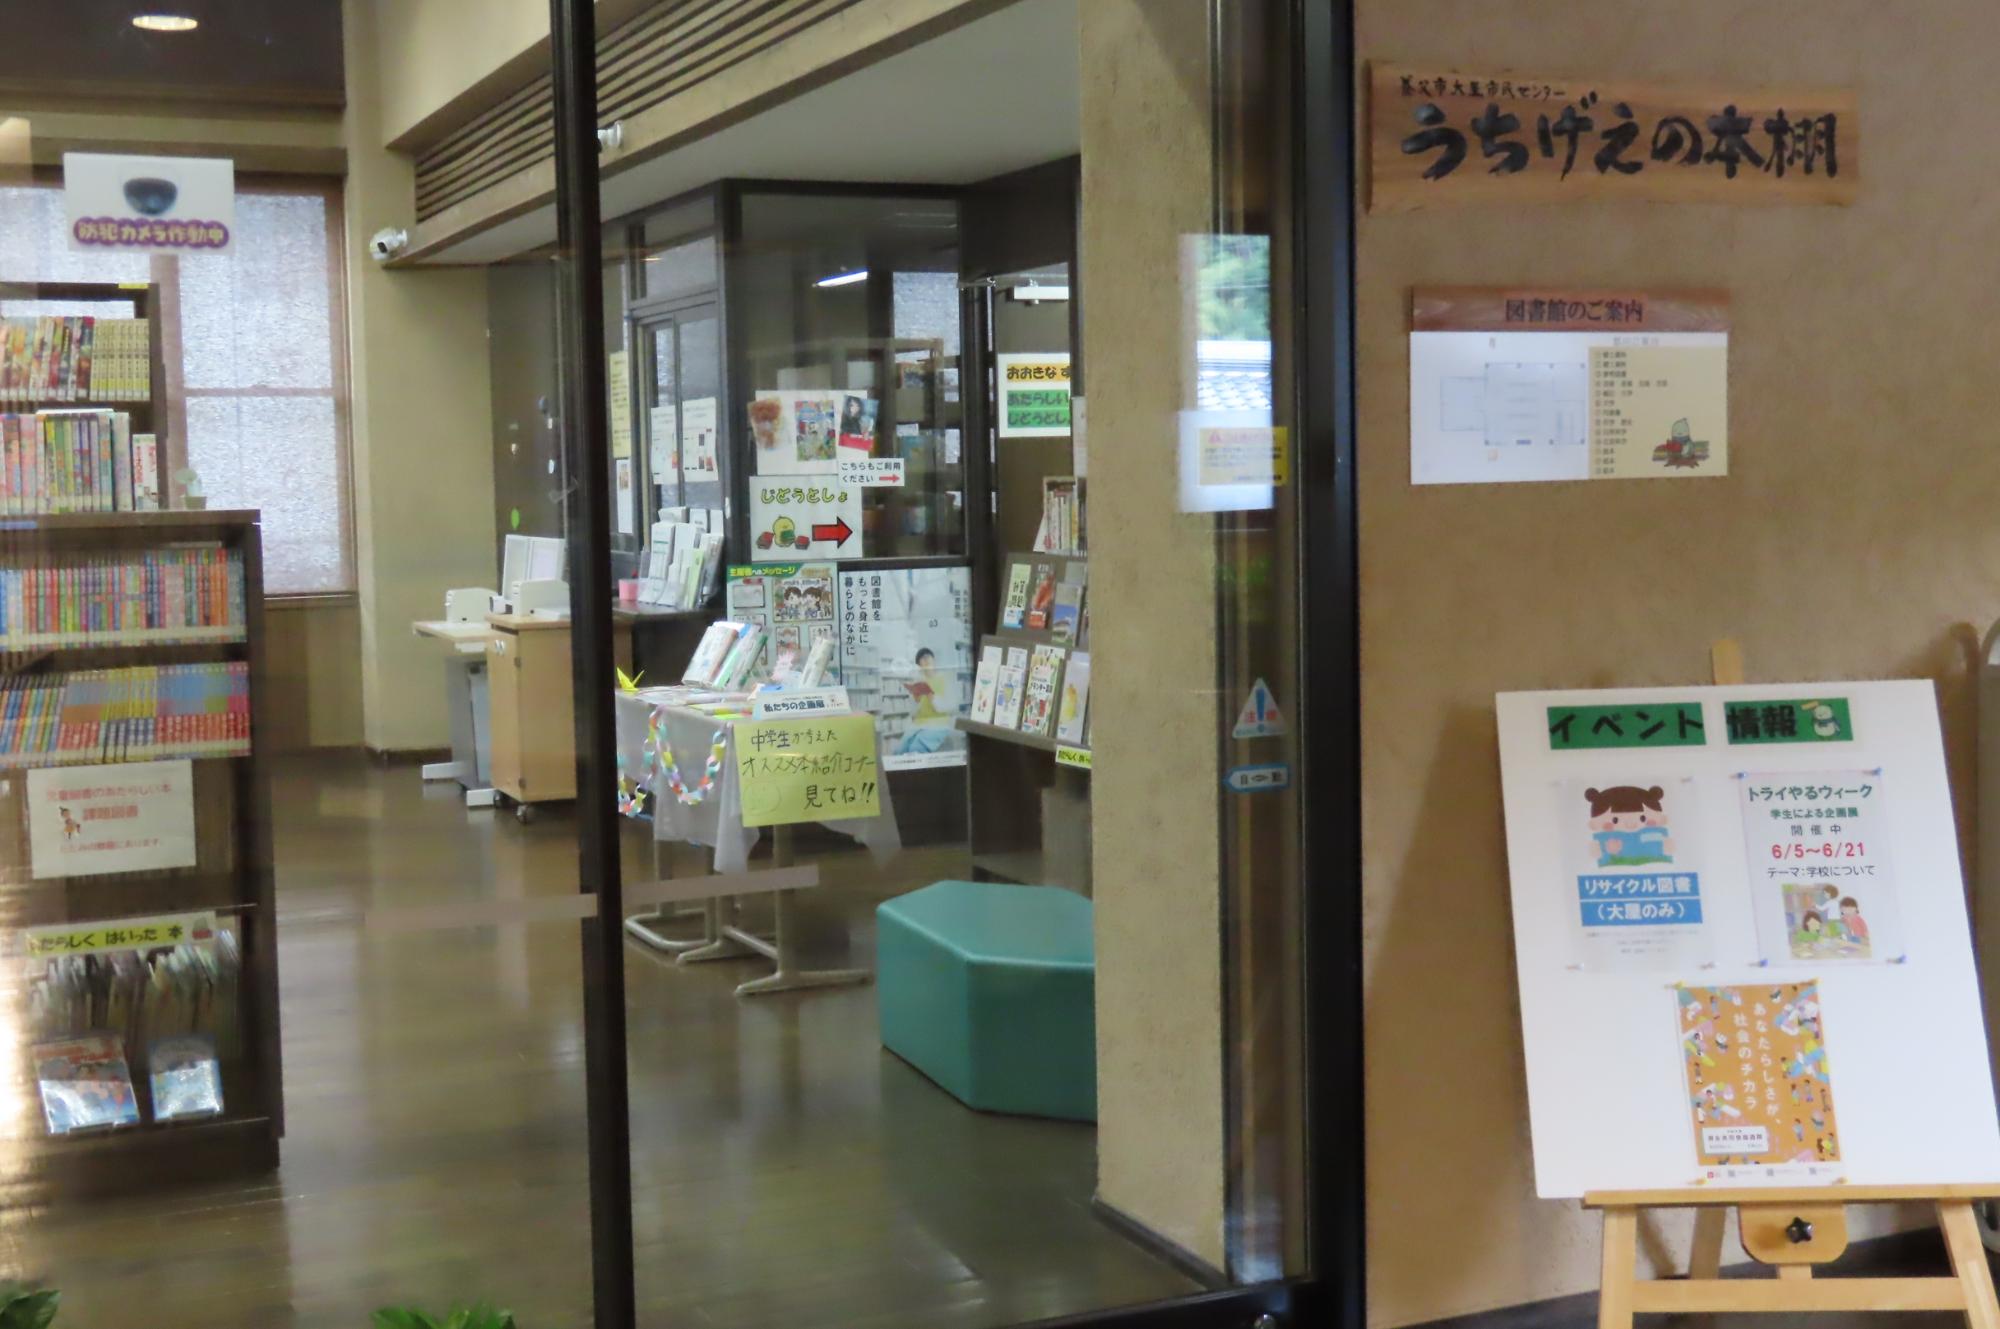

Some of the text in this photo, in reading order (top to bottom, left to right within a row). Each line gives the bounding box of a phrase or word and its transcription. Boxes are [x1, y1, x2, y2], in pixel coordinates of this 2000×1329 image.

[1401, 91, 1838, 181] うちげえの本棚
[1505, 299, 1643, 322] 図書館のご案内
[1007, 365, 1057, 380] おおきな
[1007, 411, 1070, 426] じどうとし
[841, 462, 901, 471] こちらもご利用
[842, 475, 873, 483] ください
[761, 487, 848, 504] じどうとしょ
[871, 576, 882, 621] 図書館を
[845, 576, 856, 657] 暮らしのなかに
[858, 576, 869, 645] もっと身近に
[1550, 704, 1798, 743] イベント 情報
[1748, 784, 1873, 802] トライやるウィーク
[1770, 807, 1859, 819] 学生による企画展
[1584, 876, 1691, 895] リサイクル図書
[105, 929, 157, 946] はいった
[168, 925, 183, 939] 本
[1733, 1012, 1757, 1110] 社会のチカラ
